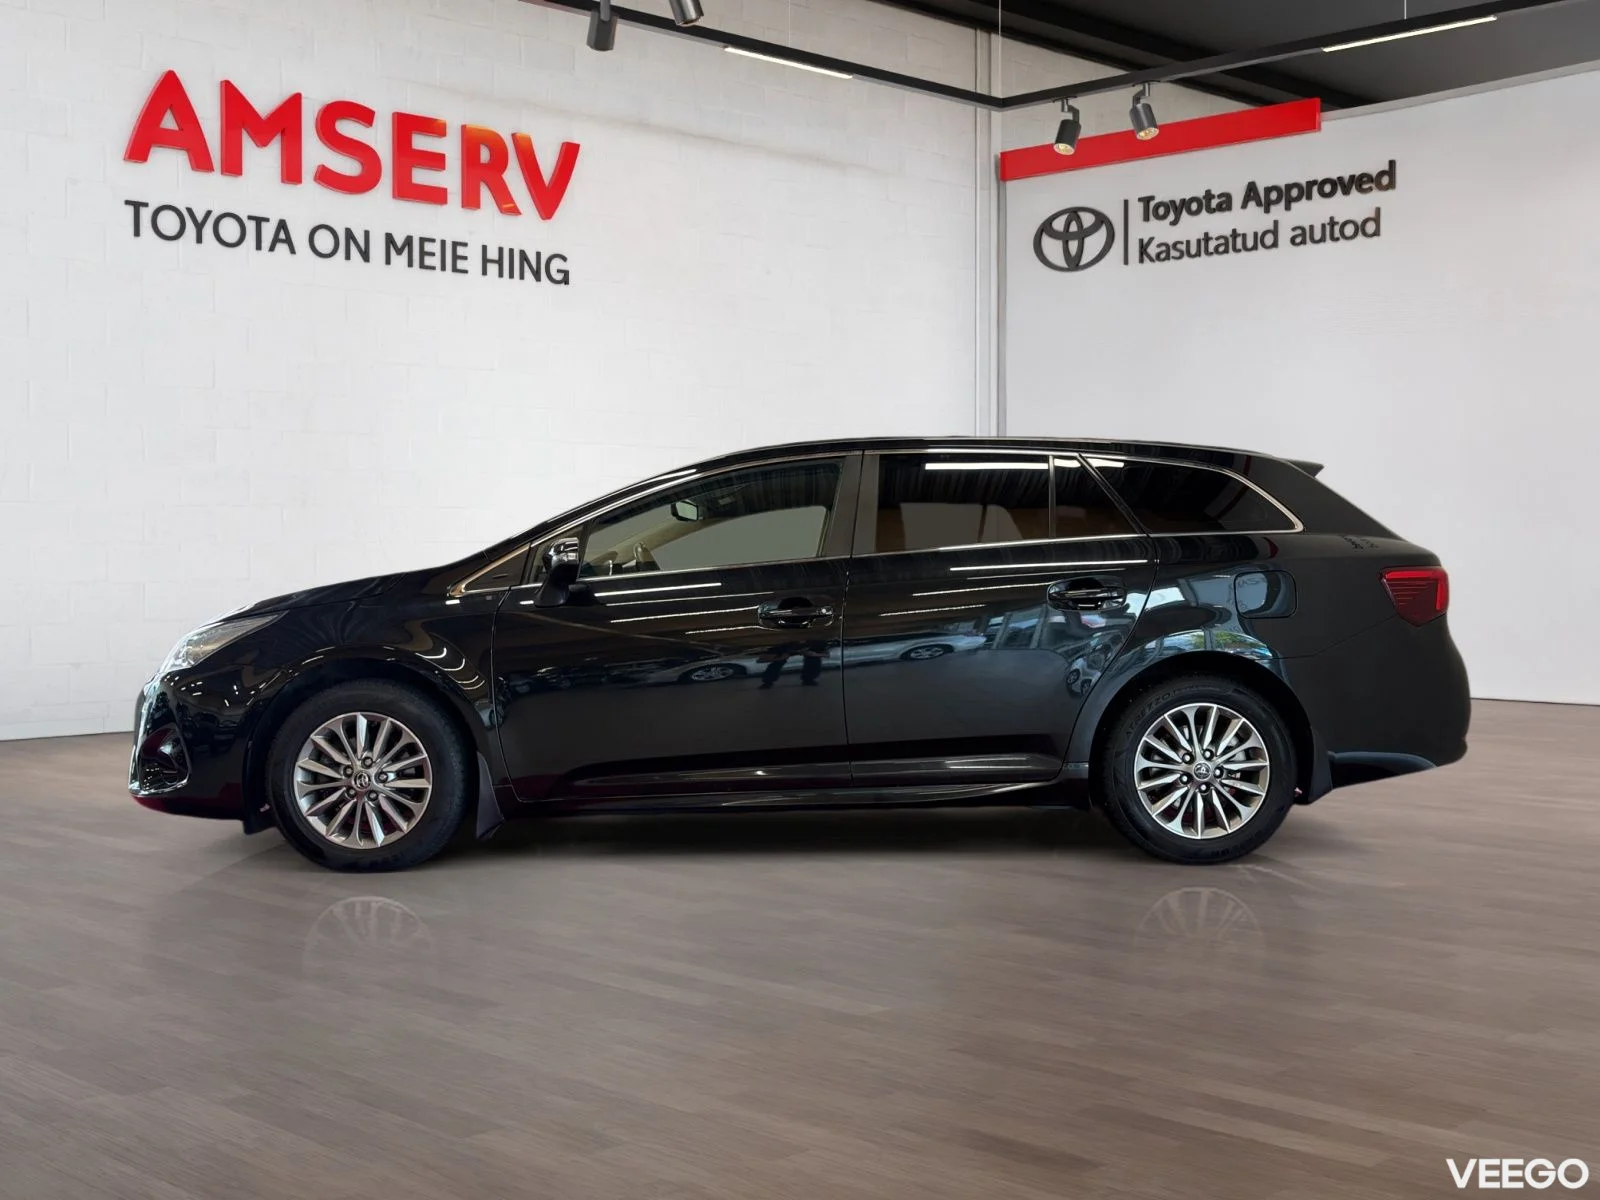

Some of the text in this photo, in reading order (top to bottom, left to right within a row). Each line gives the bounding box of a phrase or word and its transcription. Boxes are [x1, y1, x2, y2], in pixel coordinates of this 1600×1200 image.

[123, 69, 581, 221] AMSERV
[1137, 159, 1397, 227] Toyota Approved
[124, 199, 571, 286] TOYOTA ON MEIE HING
[1137, 206, 1382, 265] Kasutatud autod
